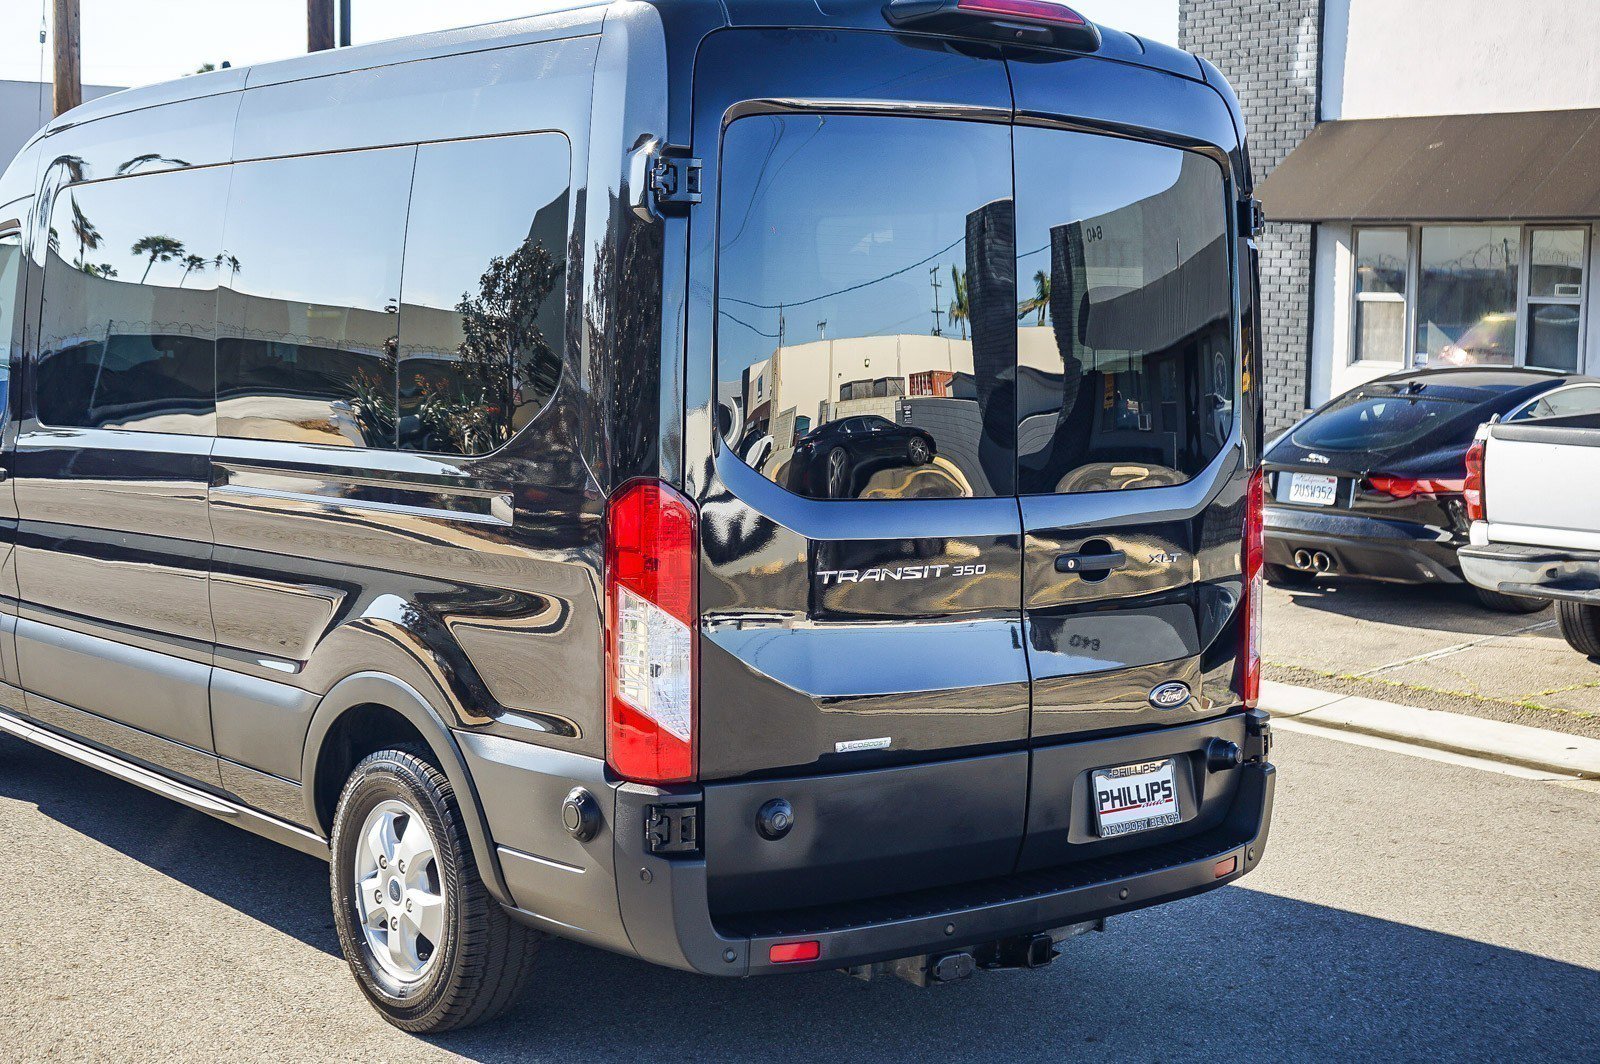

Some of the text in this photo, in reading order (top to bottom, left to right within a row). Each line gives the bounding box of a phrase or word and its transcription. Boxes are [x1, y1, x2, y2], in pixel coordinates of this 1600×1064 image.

[1147, 552, 1182, 564] XLT
[816, 563, 987, 585] TRANSIT 350
[1160, 687, 1184, 703] Ford
[847, 740, 888, 750] ECOBOOST
[1112, 763, 1157, 777] PHILLIPS
[1098, 779, 1173, 811] PHILLIPS
[1102, 812, 1180, 836] NEWPORT BEACH
